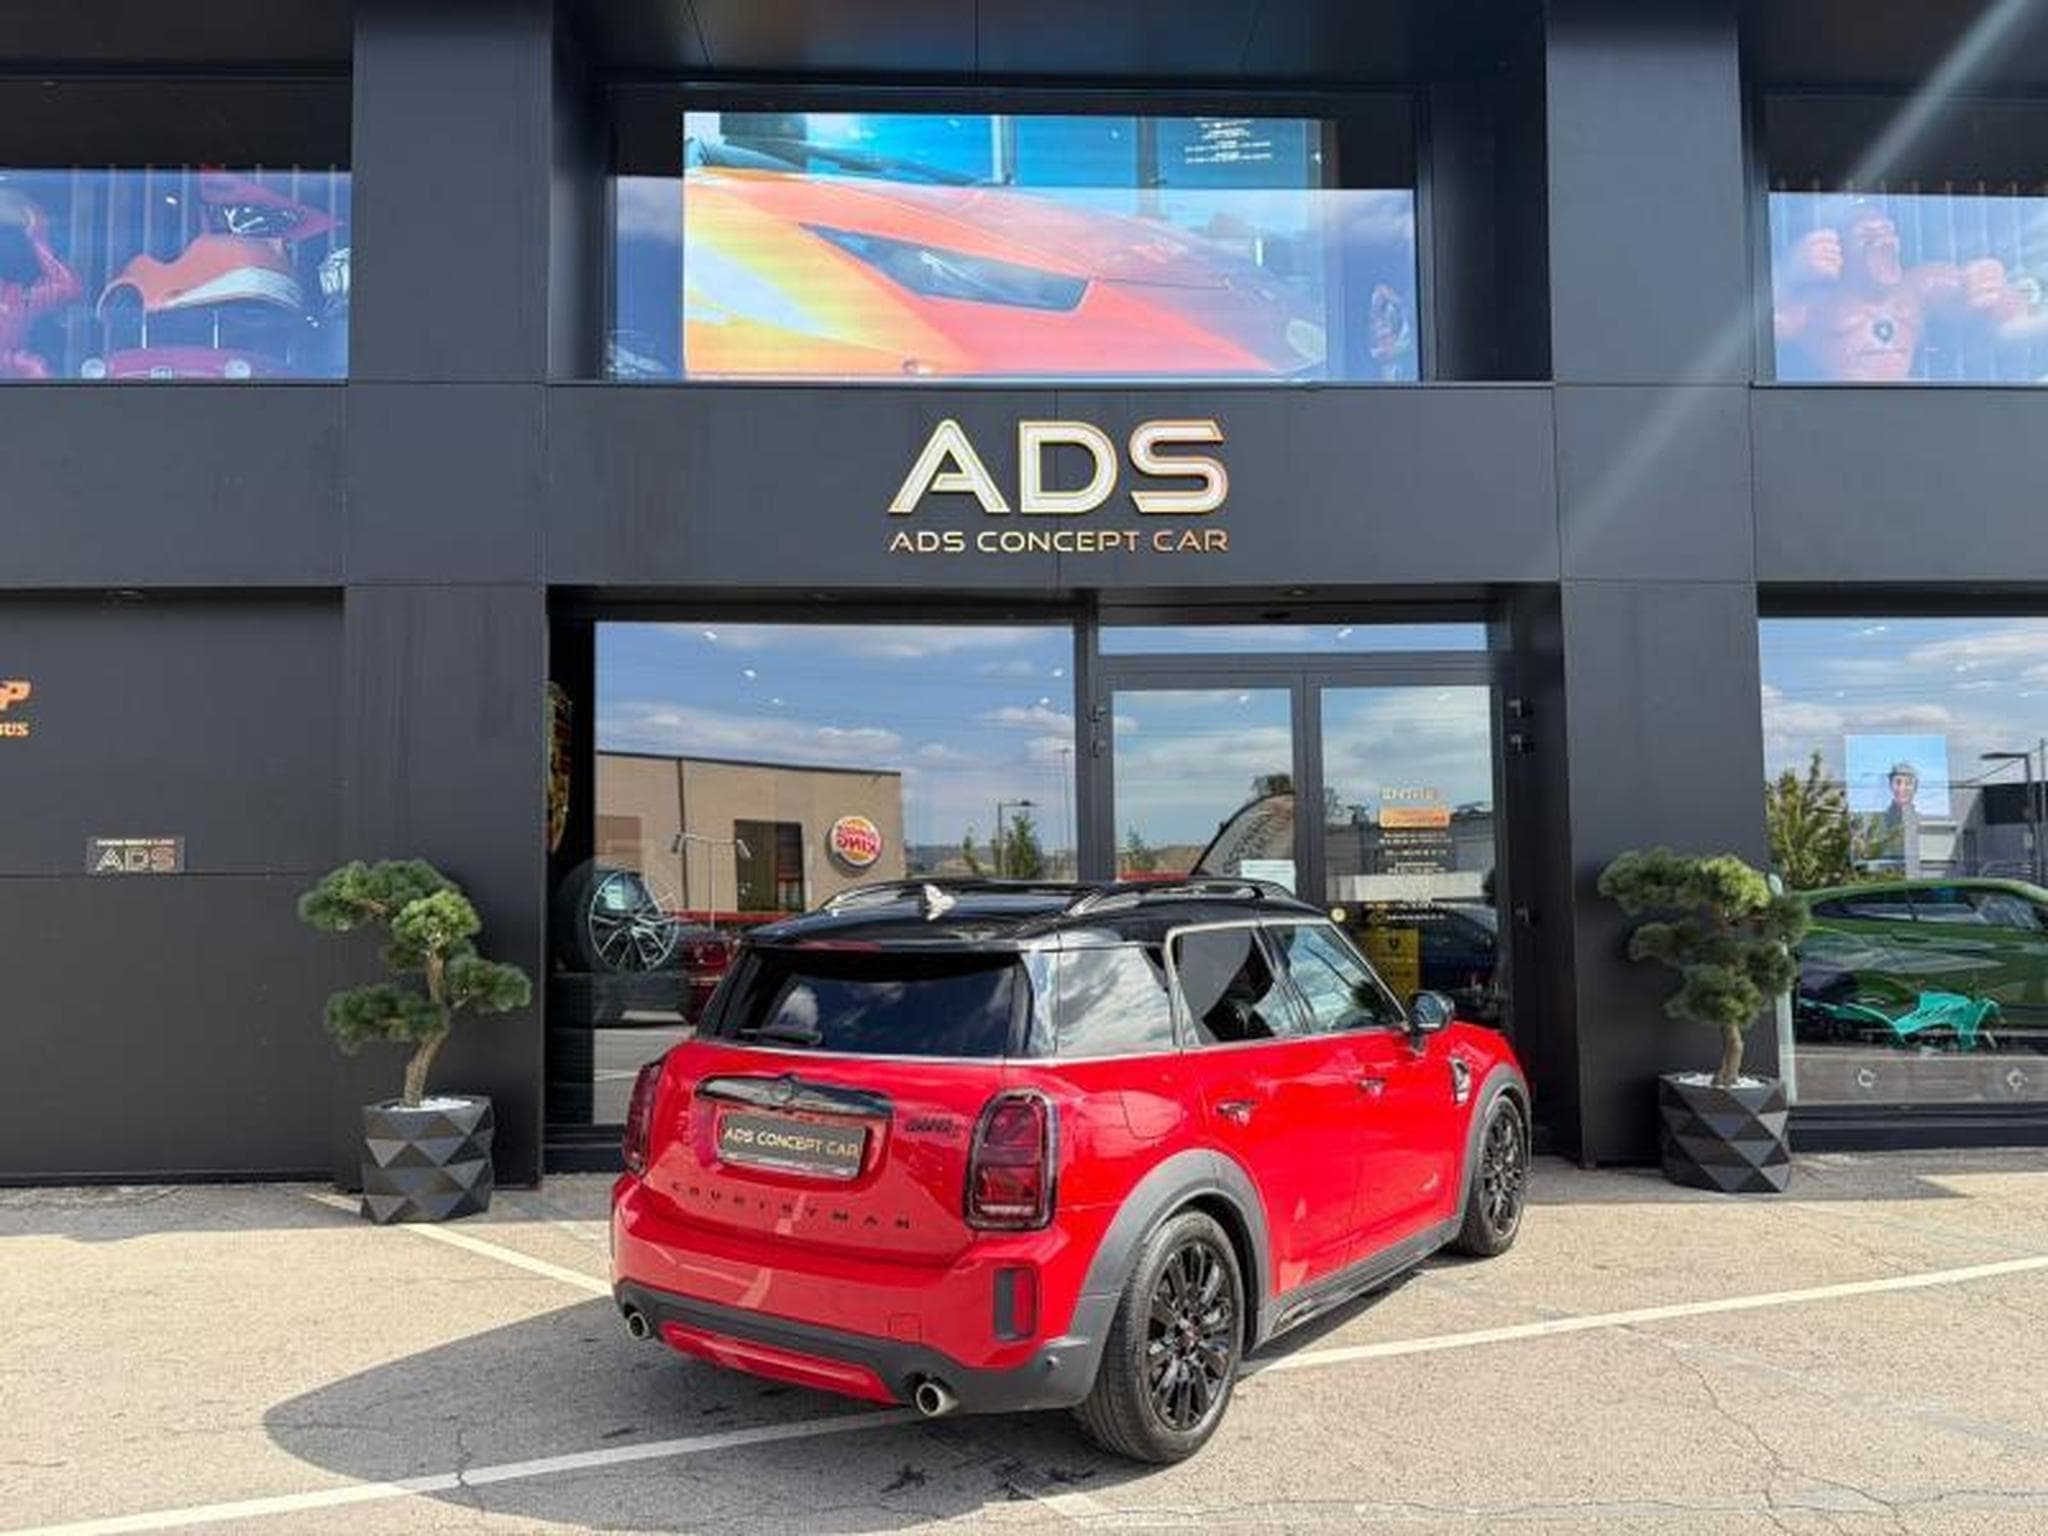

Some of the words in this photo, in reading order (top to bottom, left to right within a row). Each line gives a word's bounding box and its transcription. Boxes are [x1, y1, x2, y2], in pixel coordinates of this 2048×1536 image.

[888, 419, 1229, 513] ADS
[890, 530, 966, 552] ADS
[977, 530, 1140, 552] CONCEPT
[1153, 529, 1229, 552] CAR
[97, 847, 175, 871] ADS
[724, 1127, 754, 1144] ADS
[757, 1130, 822, 1153] CONCEPT
[826, 1141, 860, 1158] CAR
